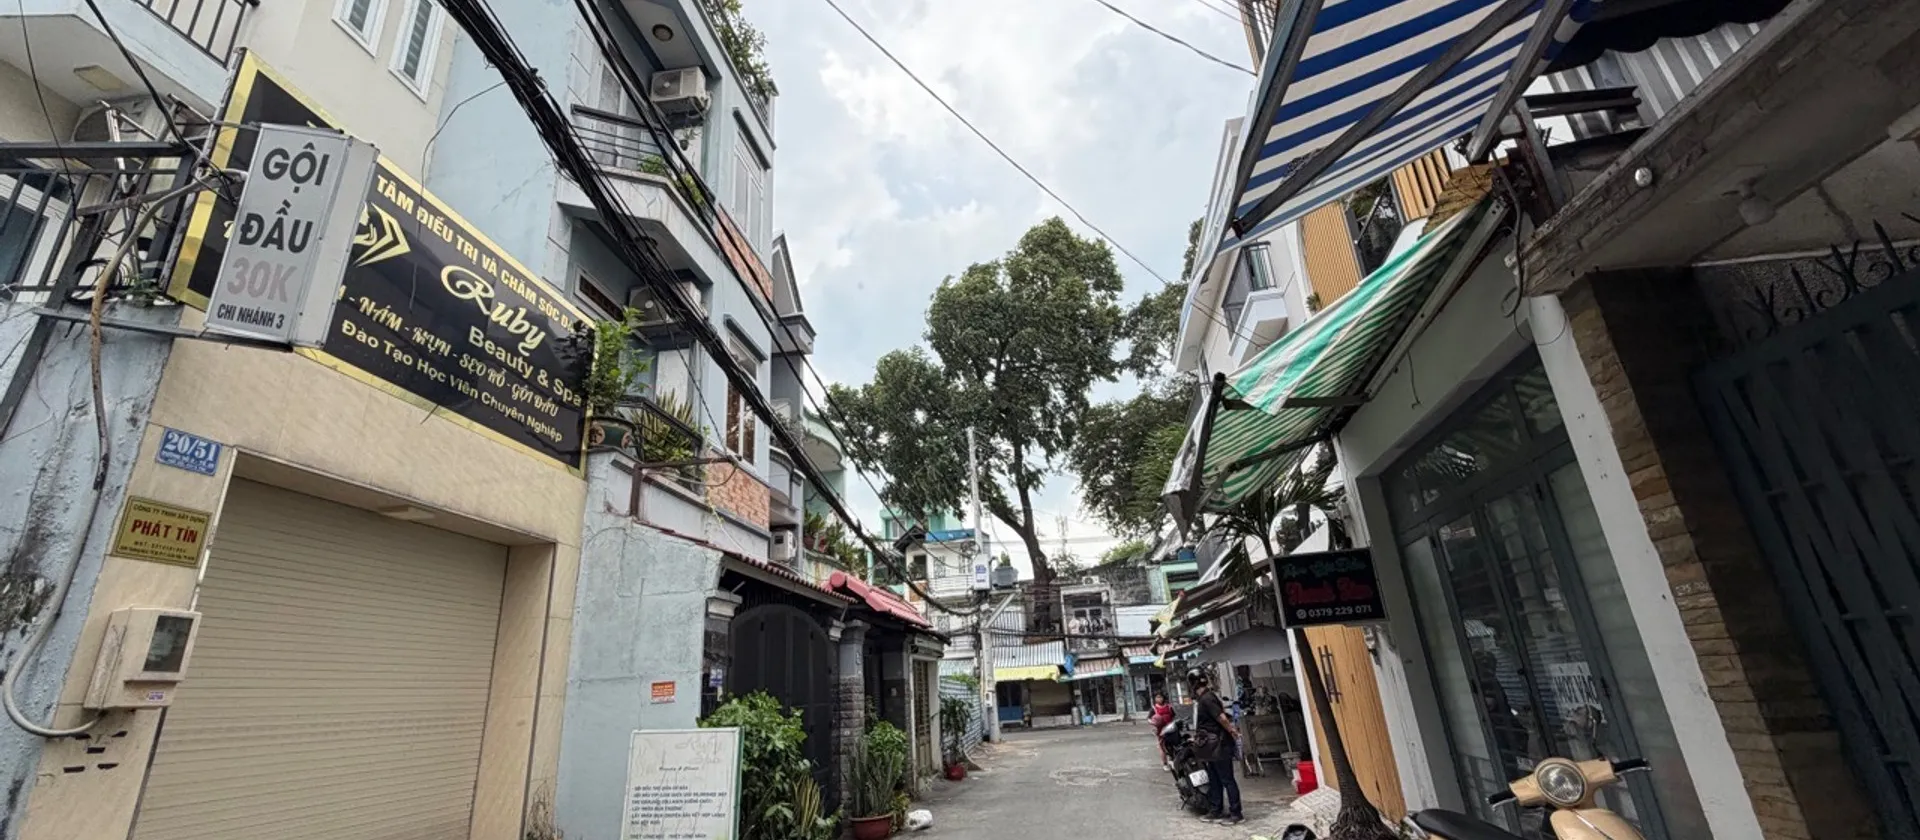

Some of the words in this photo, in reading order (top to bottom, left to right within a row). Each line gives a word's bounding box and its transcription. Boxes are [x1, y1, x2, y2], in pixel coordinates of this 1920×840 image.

[262, 142, 330, 194] GỘI
[238, 199, 314, 254] ĐẦU
[226, 256, 298, 303] 30K
[455, 235, 479, 265] TRỊ
[482, 254, 498, 278] VÀ
[501, 269, 537, 305] CHĂM
[539, 297, 560, 321] SÓC
[217, 303, 237, 321] CHI
[237, 306, 276, 328] NHÁNH
[276, 313, 285, 330] 3
[440, 265, 546, 357] Ruby
[341, 319, 379, 348] Đào
[383, 339, 413, 365] Tạo
[416, 358, 447, 383] Học
[450, 374, 479, 399] Viên
[481, 391, 525, 422] Chuyên
[526, 415, 563, 442] Nghiệp
[468, 325, 534, 379] Beauty
[537, 368, 549, 388] &
[553, 377, 582, 407] Spa
[163, 431, 217, 462] 20/51
[130, 519, 172, 538] PHÁT
[175, 525, 198, 544] TÍN
[1308, 607, 1333, 617] 0379
[1335, 606, 1353, 616] 229
